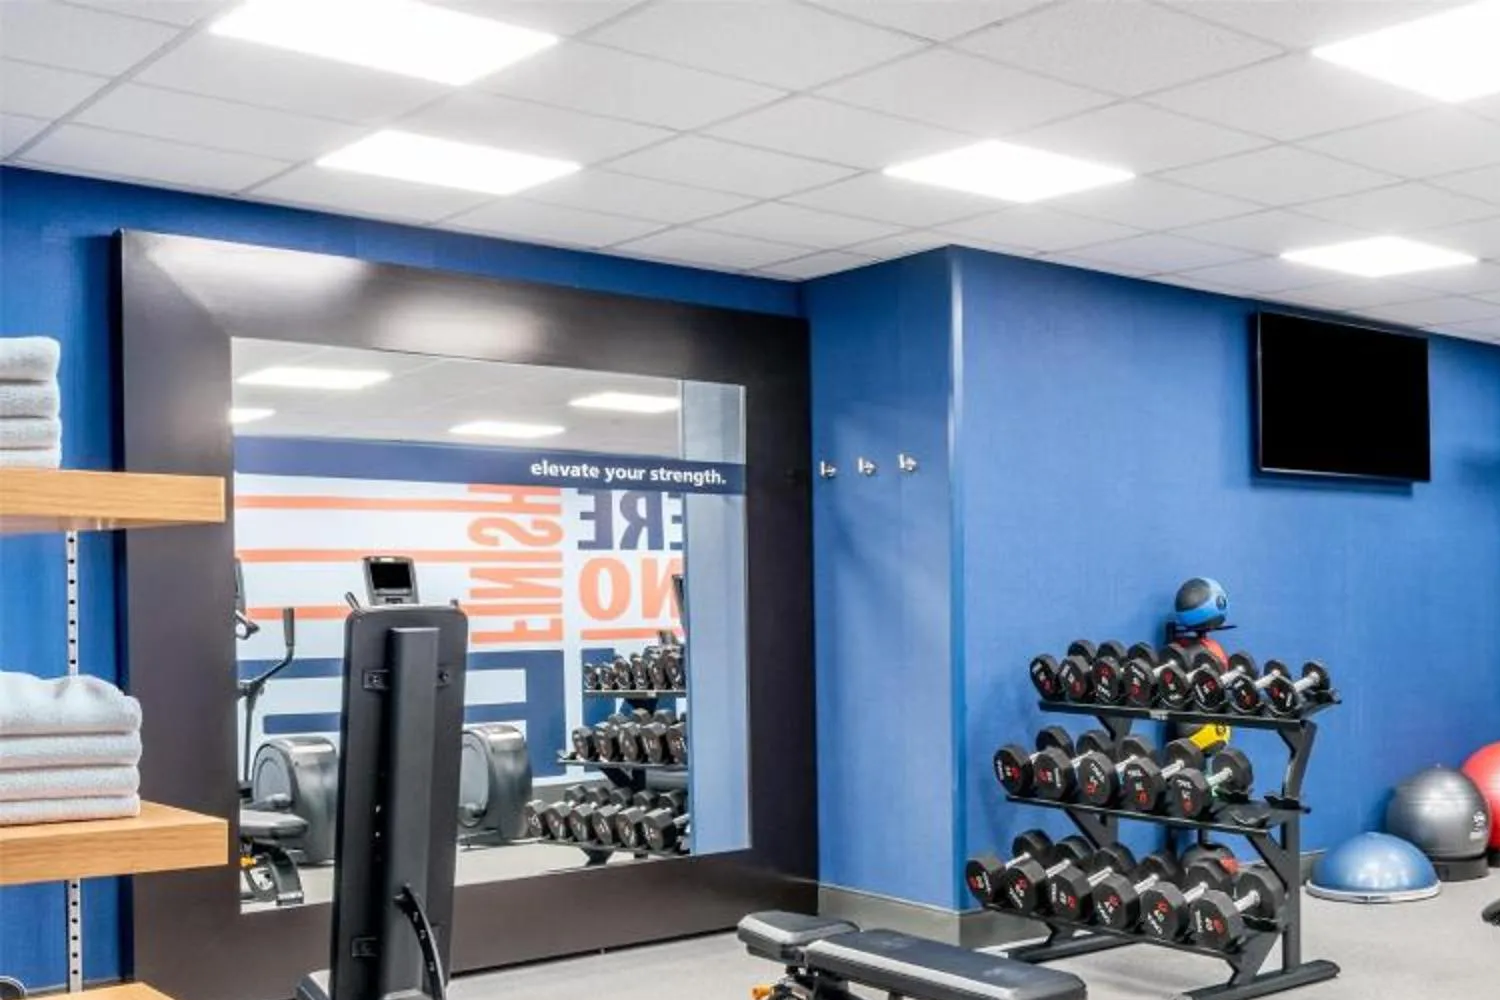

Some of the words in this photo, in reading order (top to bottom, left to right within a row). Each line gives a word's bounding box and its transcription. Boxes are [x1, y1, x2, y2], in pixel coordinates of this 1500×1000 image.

[530, 459, 600, 479] elevate
[603, 466, 646, 483] your
[650, 468, 727, 487] strength.
